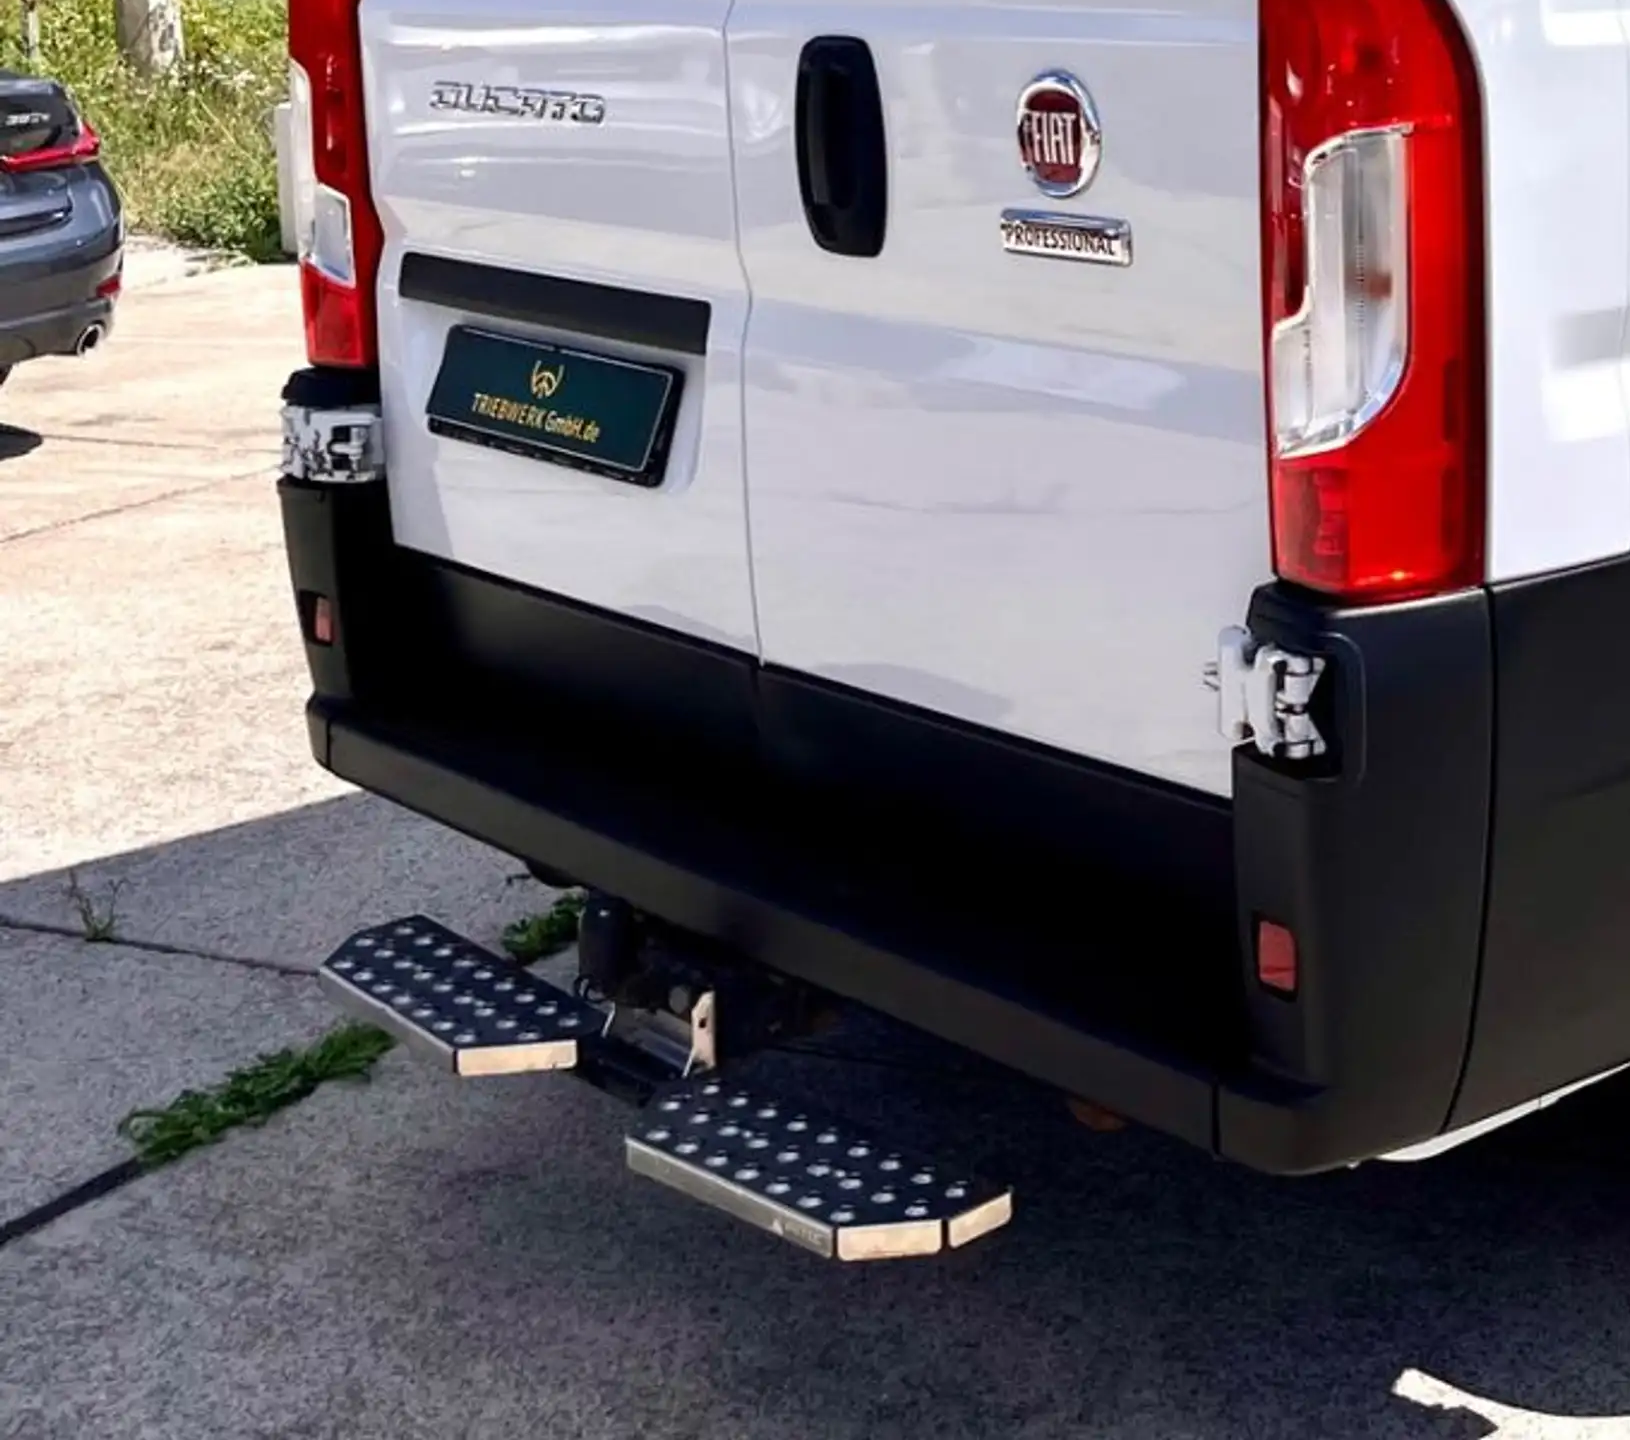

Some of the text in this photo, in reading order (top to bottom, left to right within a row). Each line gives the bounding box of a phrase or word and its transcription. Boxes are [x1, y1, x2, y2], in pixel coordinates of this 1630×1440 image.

[1031, 112, 1077, 165] FIAT
[1005, 223, 1116, 255] PROFESSIONAL
[472, 392, 547, 429] TRIEBWERK
